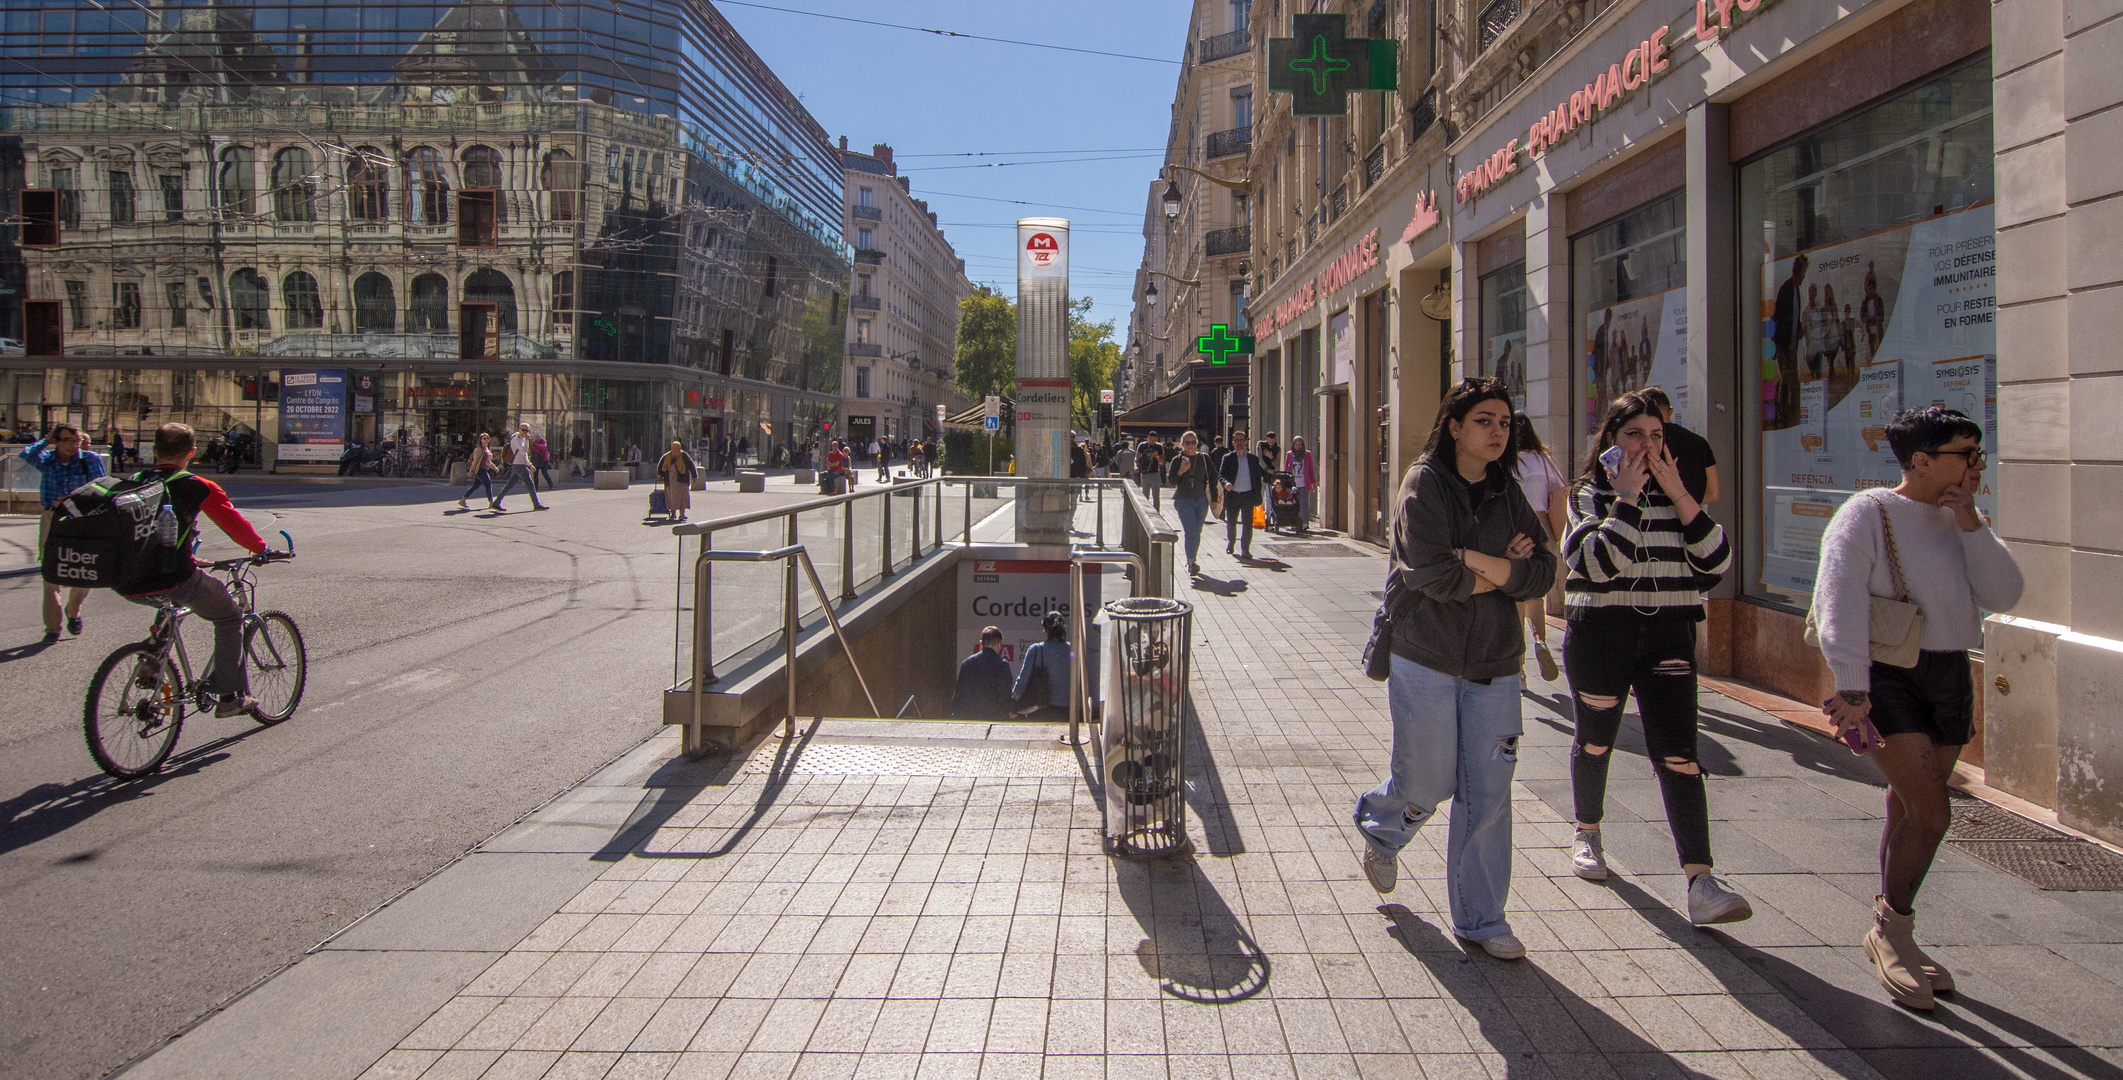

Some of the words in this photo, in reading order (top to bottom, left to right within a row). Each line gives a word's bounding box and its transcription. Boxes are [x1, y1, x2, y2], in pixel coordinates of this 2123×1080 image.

[1456, 137, 1519, 205] GRANDE
[1529, 24, 1670, 159] PHARMACIE
[1034, 238, 1050, 247] M
[1929, 244, 1954, 259] POUR
[1932, 259, 1952, 272] VOS
[1933, 265, 1996, 287] IMMUNITAIRE
[1254, 311, 1275, 345] GRANDE
[1275, 278, 1316, 330] PHARMACIE
[1318, 227, 1379, 300] LYONNAISE
[1936, 302, 1962, 316] POUR
[1944, 317, 1957, 329] EN
[1958, 312, 1993, 328] FORME
[1866, 383, 1890, 391] DEFENCIA
[1943, 379, 1972, 388] DEFENCIA
[304, 389, 322, 397] LYON
[407, 386, 473, 398] MONOPRIX
[1017, 392, 1066, 404] Cordeliers
[286, 397, 307, 405] Centre
[307, 397, 315, 405] de
[315, 397, 340, 406] Congrès
[286, 405, 295, 414] 20
[295, 405, 323, 414] OCTOBRE
[324, 405, 339, 414] 2022
[1791, 473, 1834, 485] DEFENCIA
[1854, 478, 1898, 489] DEFENCI
[130, 504, 158, 522] Ube
[58, 547, 98, 564] Uber
[57, 564, 98, 580] Eats
[972, 595, 1093, 618] Cordelies
[1001, 649, 1011, 660] A
